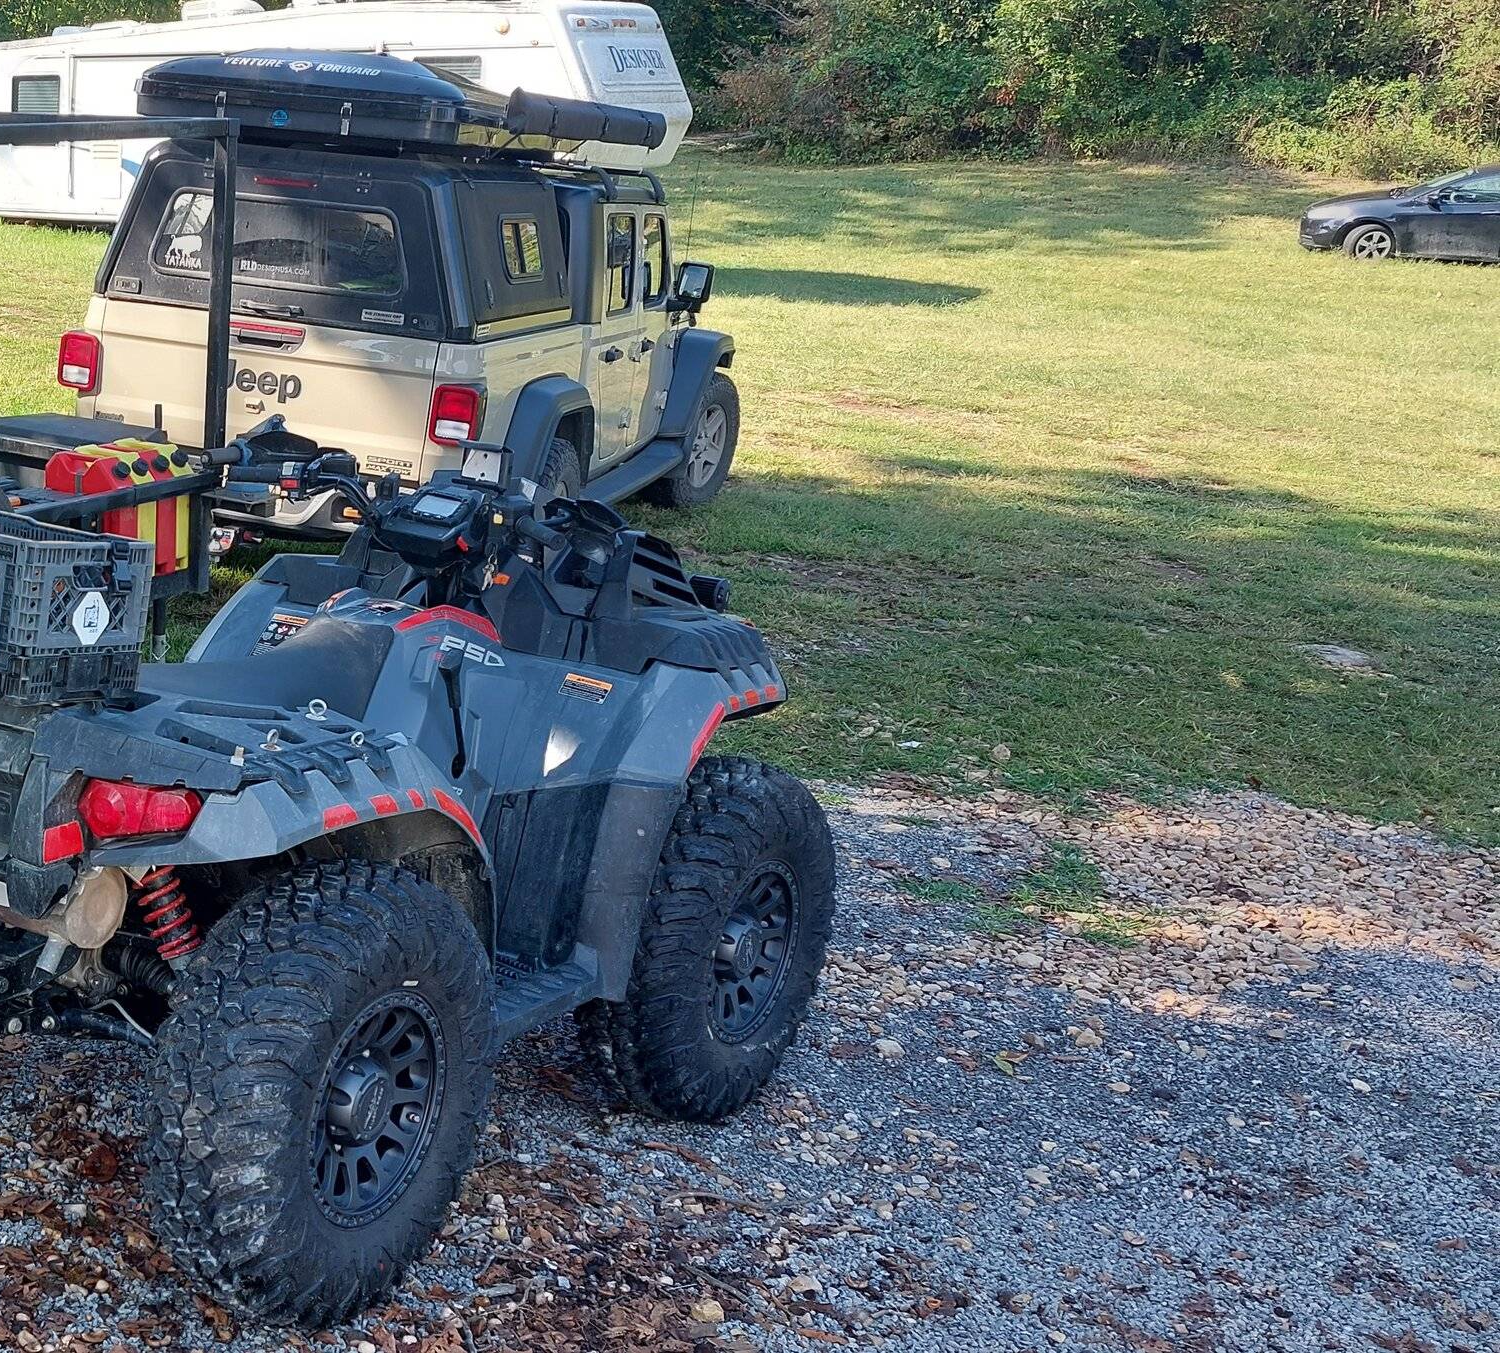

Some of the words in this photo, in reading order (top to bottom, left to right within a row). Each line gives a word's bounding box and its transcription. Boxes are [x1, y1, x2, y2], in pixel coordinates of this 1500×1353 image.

[223, 56, 285, 68] VENTURE
[316, 63, 381, 76] FORWARD
[607, 45, 666, 73] DESIGNER
[164, 254, 202, 269] TATANKA
